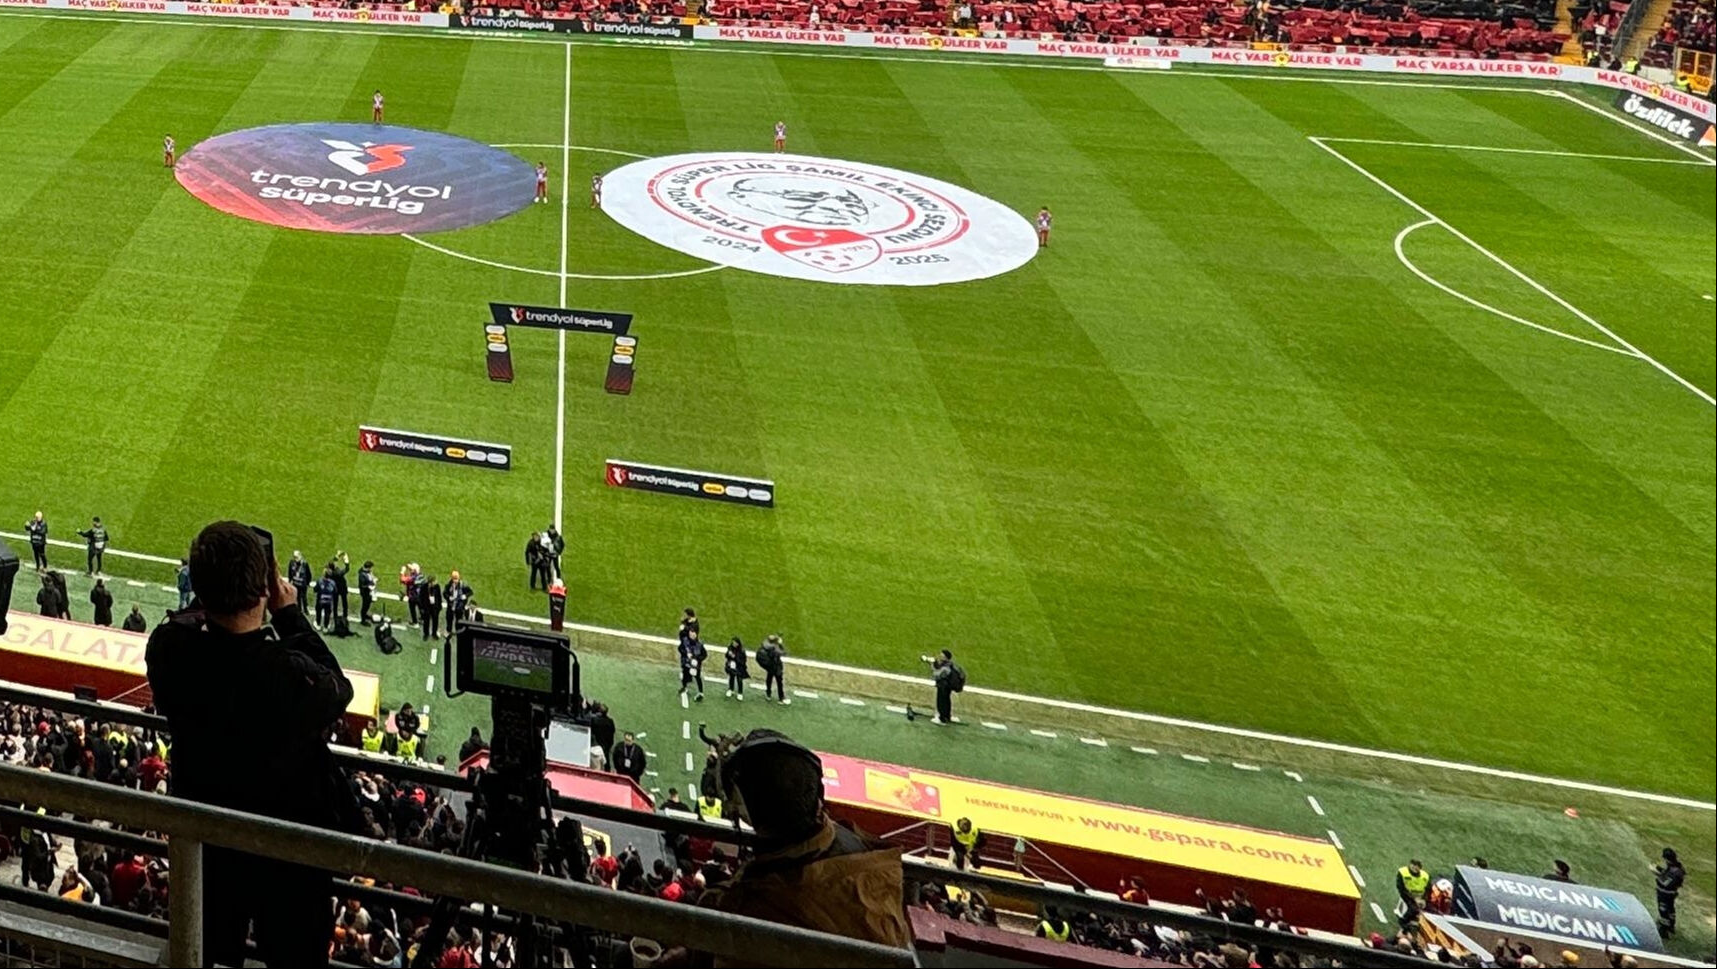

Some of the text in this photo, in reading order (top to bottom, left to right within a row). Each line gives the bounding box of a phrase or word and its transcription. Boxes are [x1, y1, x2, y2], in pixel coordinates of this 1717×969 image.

[68, 0, 87, 7] MAÇ
[187, 4, 208, 14] MAÇ
[210, 5, 238, 14] VARSA
[313, 11, 334, 21] MAÇ
[402, 15, 420, 23] VAR
[471, 16, 519, 29] trendyol
[594, 21, 643, 35] trendyol
[719, 28, 846, 42] MAÇ VARSA ÜLKER VAR
[874, 36, 899, 48] MAÇ
[984, 41, 1008, 50] VAR
[1038, 43, 1180, 58] MAÇ VARSA ÜLKER VAR
[1212, 51, 1241, 63] MAÇ
[1336, 56, 1363, 66] VAR
[1396, 59, 1560, 76] MAÇ VARSA ÜLKER VAR
[1597, 70, 1628, 85] MAÇ
[1690, 96, 1711, 114] VAR
[1623, 94, 1696, 139] Özdilek
[671, 165, 732, 186] SÜPER
[250, 169, 452, 200] trendyol
[667, 187, 750, 233] TRENDYOL
[702, 235, 762, 253] 2024
[889, 254, 950, 266] 2025
[526, 310, 573, 327] trendyol
[965, 796, 1011, 812] HEMEN
[1079, 815, 1326, 869] www.gspara.com.tr
[1484, 876, 1610, 911] MEDICANA
[1497, 904, 1624, 944] MEDICANA
